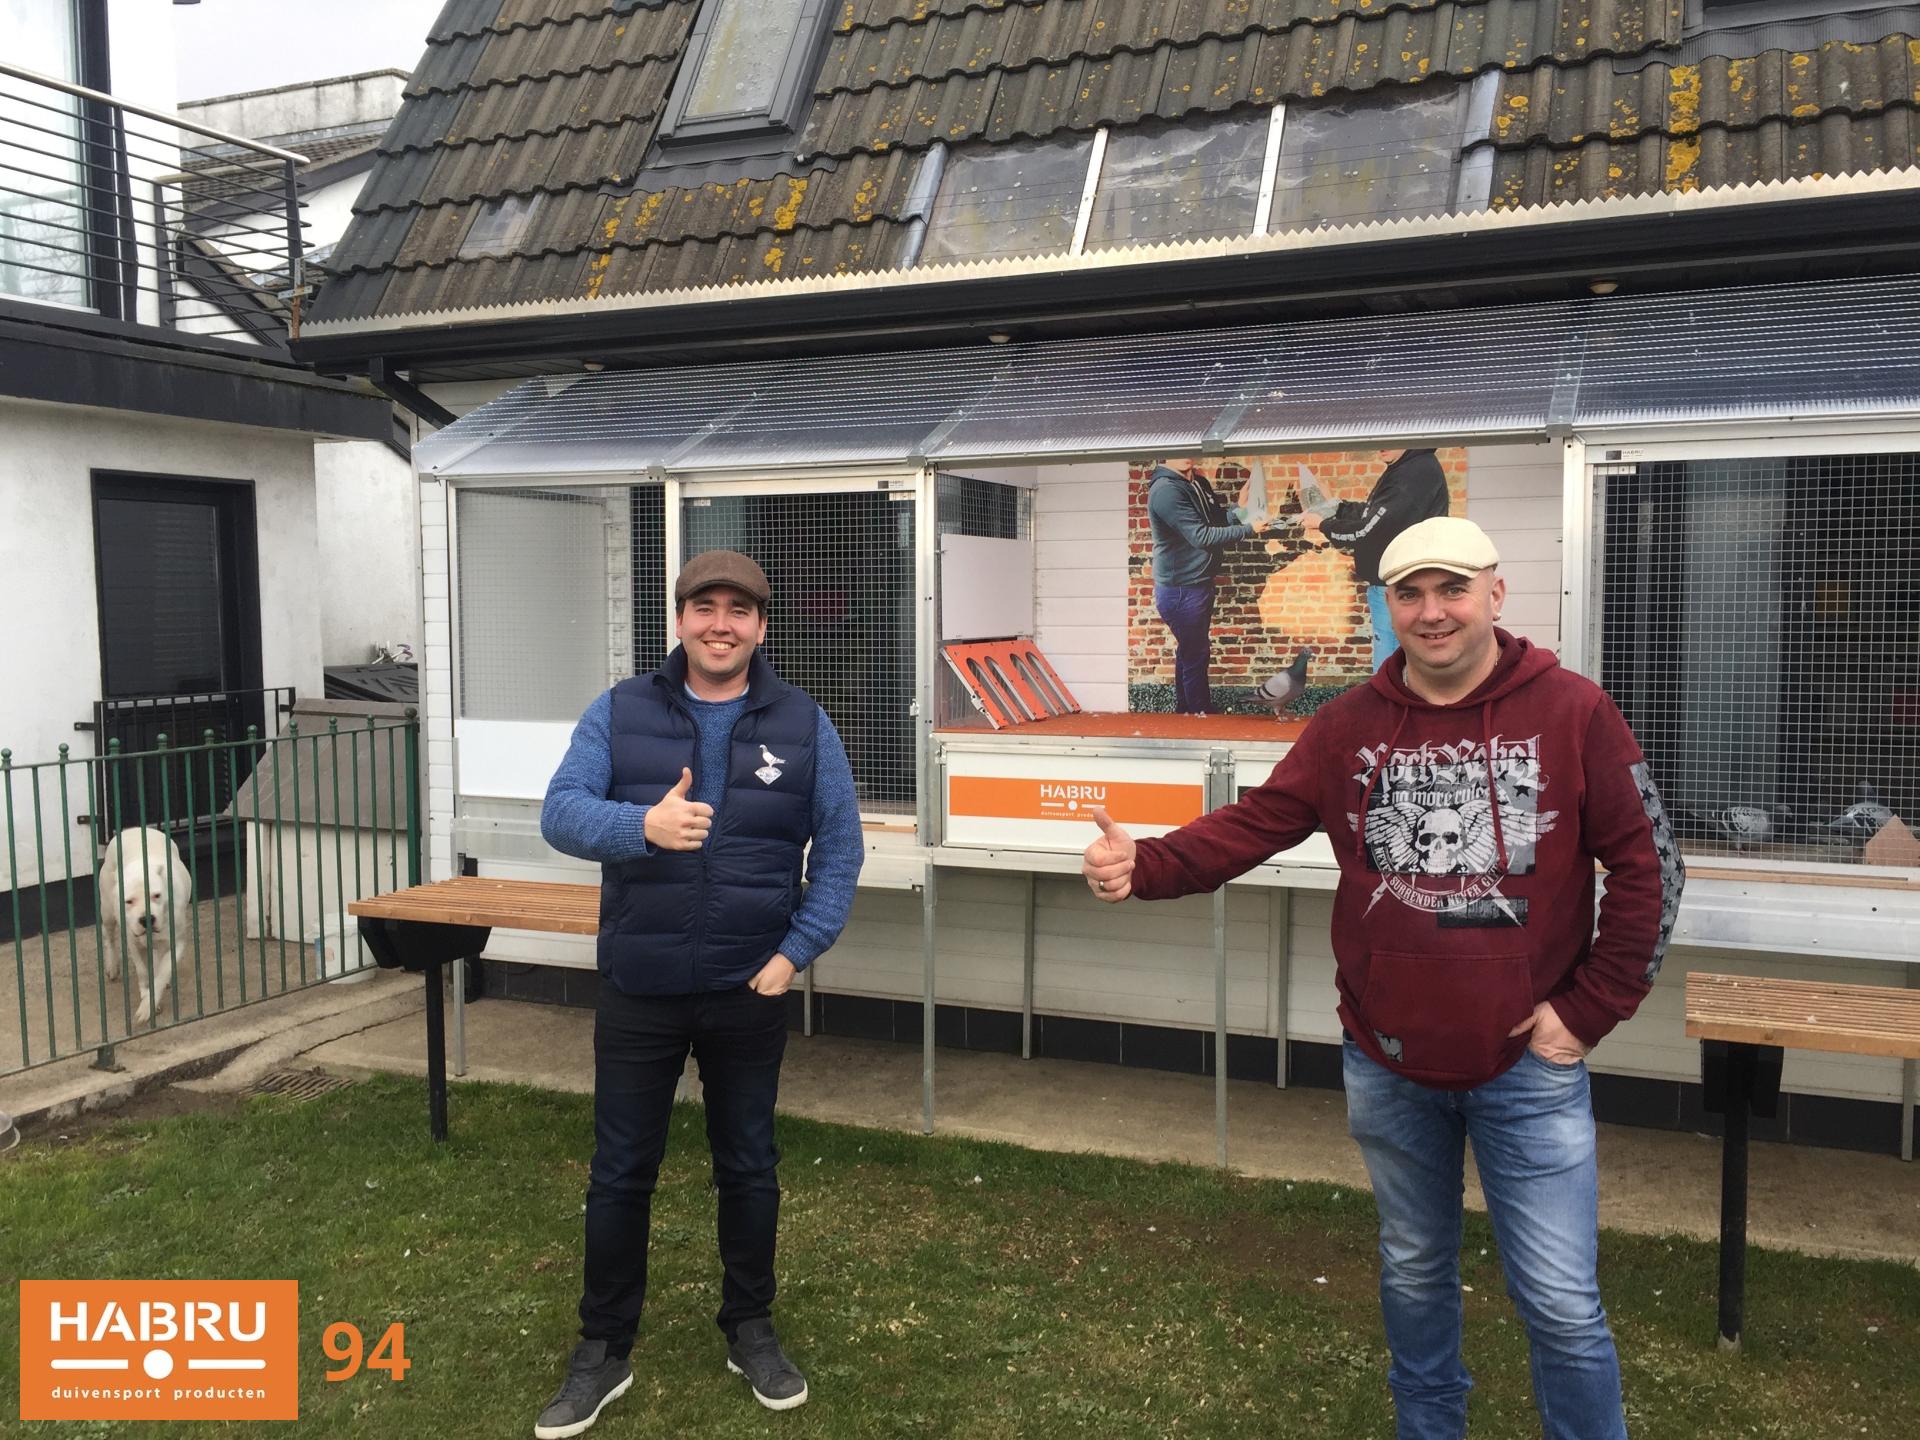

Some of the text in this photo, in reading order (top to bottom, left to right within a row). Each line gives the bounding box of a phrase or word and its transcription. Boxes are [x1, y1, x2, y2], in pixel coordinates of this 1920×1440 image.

[1040, 784, 1106, 800] HABRU
[1392, 790, 1410, 803] no
[1412, 790, 1452, 808] more
[1389, 875, 1445, 909] SURRENDER
[1446, 883, 1482, 908] NEVER
